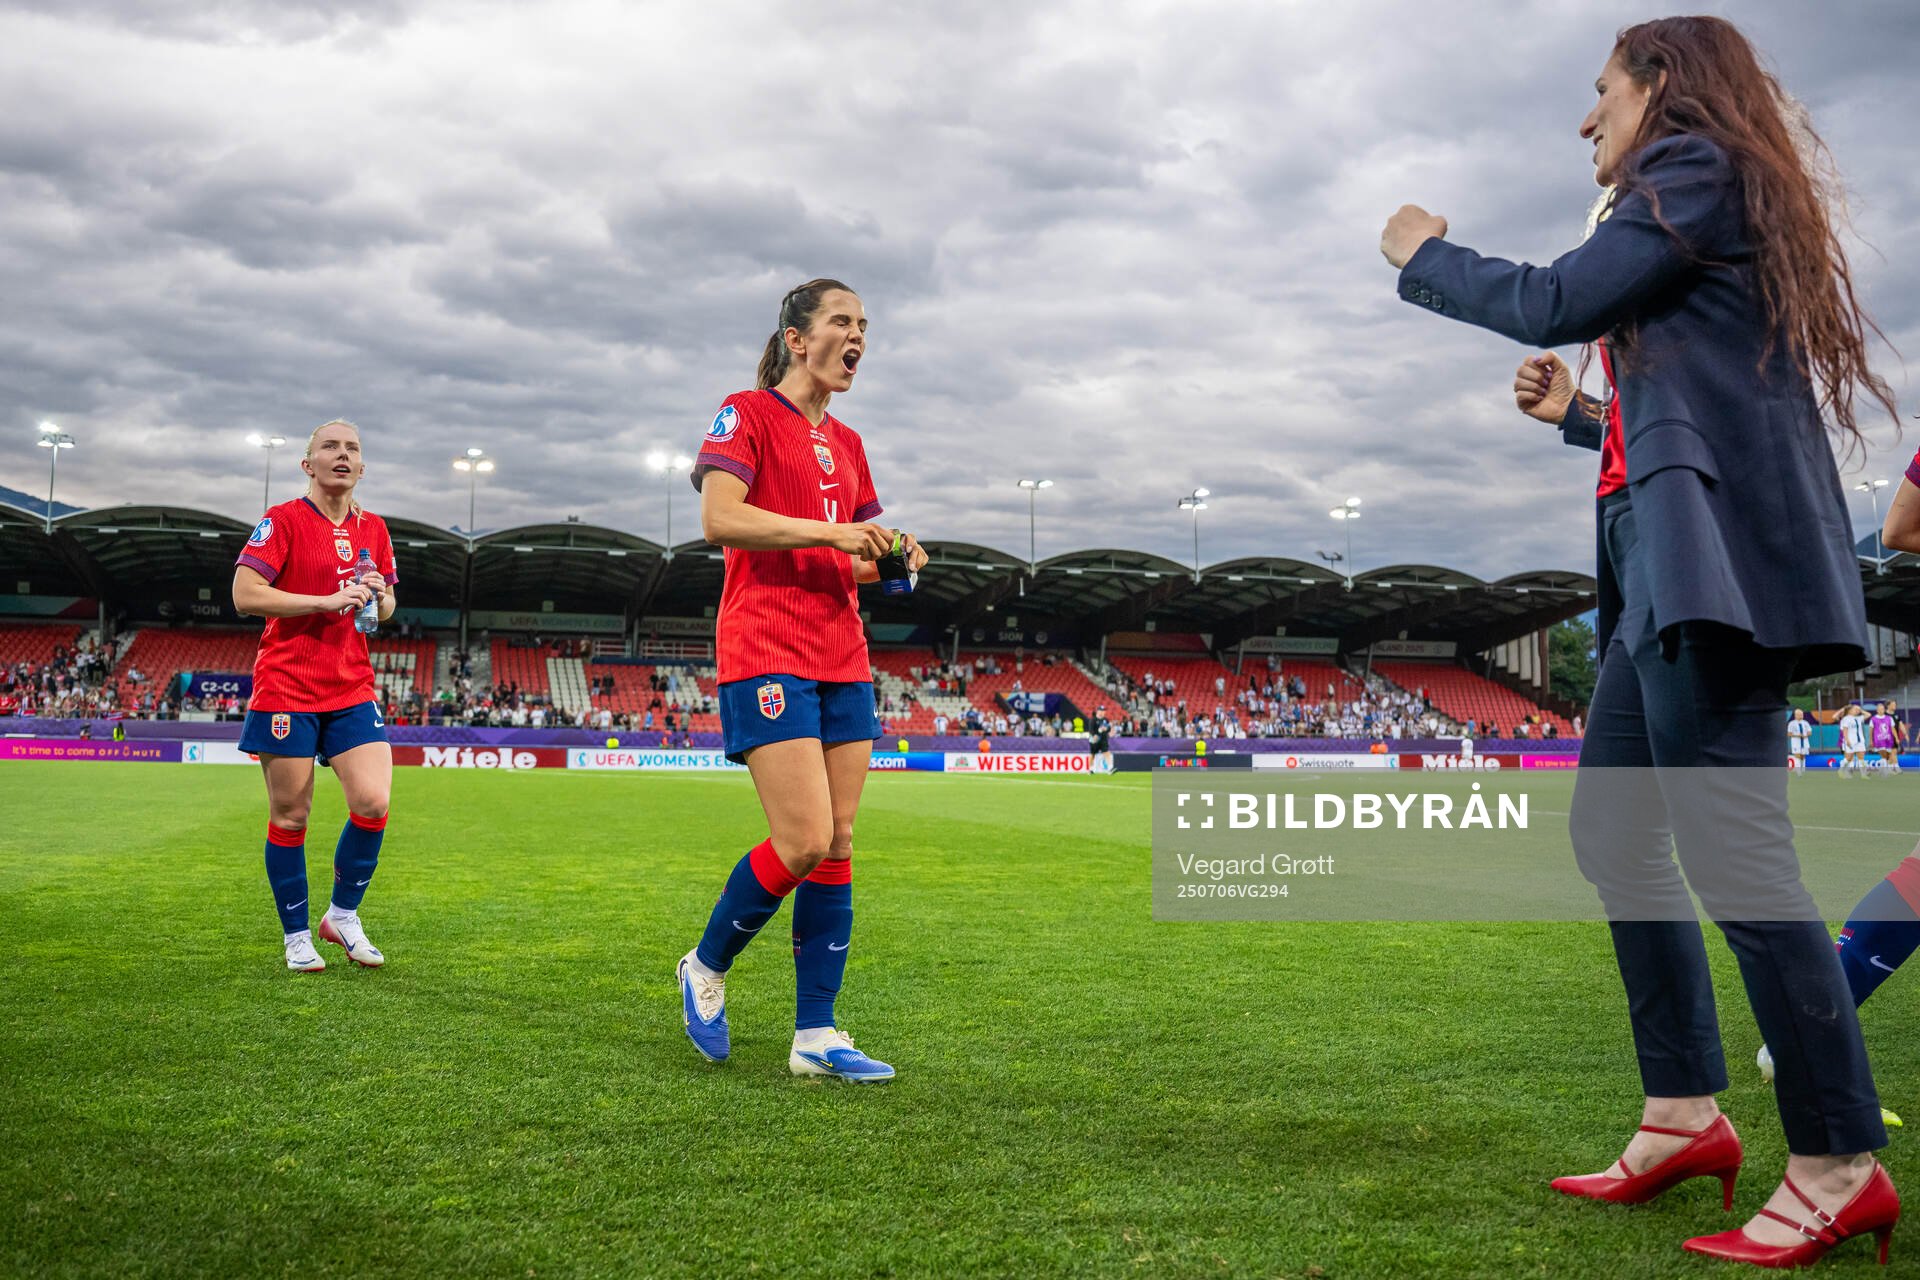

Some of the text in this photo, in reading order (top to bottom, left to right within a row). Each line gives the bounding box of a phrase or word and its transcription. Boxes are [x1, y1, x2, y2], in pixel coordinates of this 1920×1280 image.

[201, 682, 240, 693] C2-C4
[12, 745, 27, 755] It's
[29, 746, 52, 756] time
[54, 747, 65, 756] to
[67, 748, 96, 757] come
[133, 750, 161, 758] MUTE
[422, 747, 537, 769] Miele
[595, 754, 635, 766] UEFA
[639, 754, 709, 767] WOMEN'S
[1299, 757, 1355, 770] Swissquote
